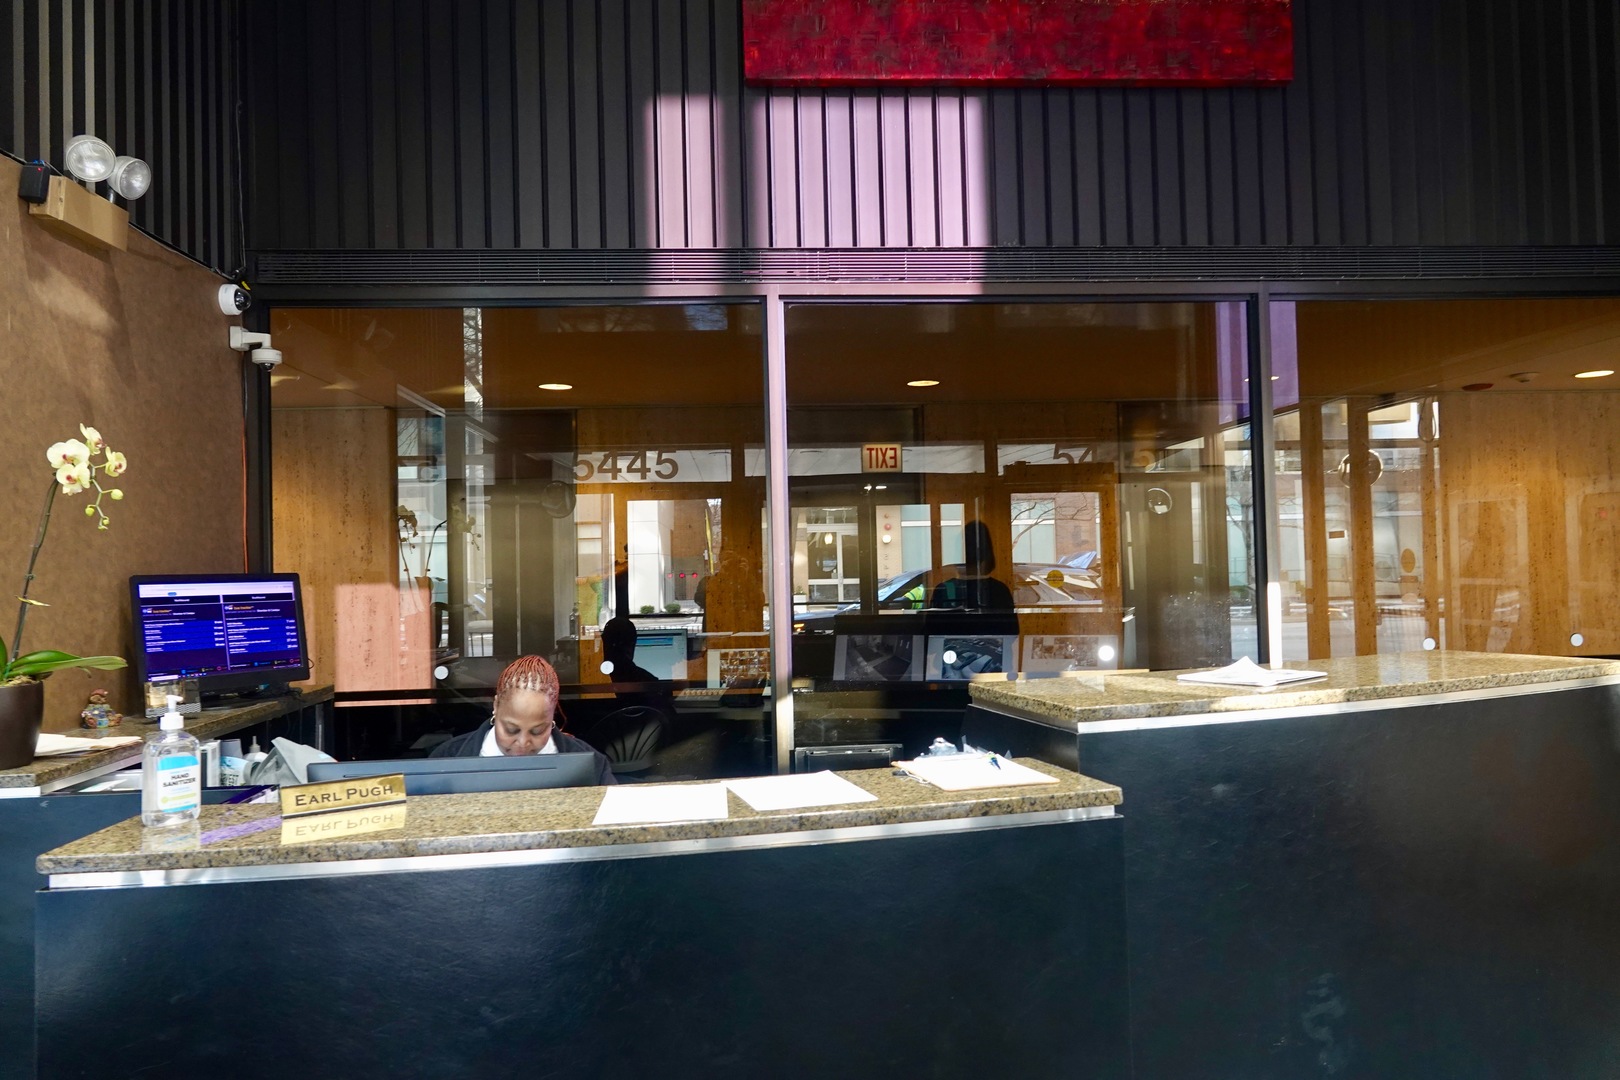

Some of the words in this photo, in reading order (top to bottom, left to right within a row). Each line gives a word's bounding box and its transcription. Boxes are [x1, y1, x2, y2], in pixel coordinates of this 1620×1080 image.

[163, 777, 196, 788] SANITIZER
[295, 792, 342, 806] EARL
[346, 785, 393, 800] PUGH
